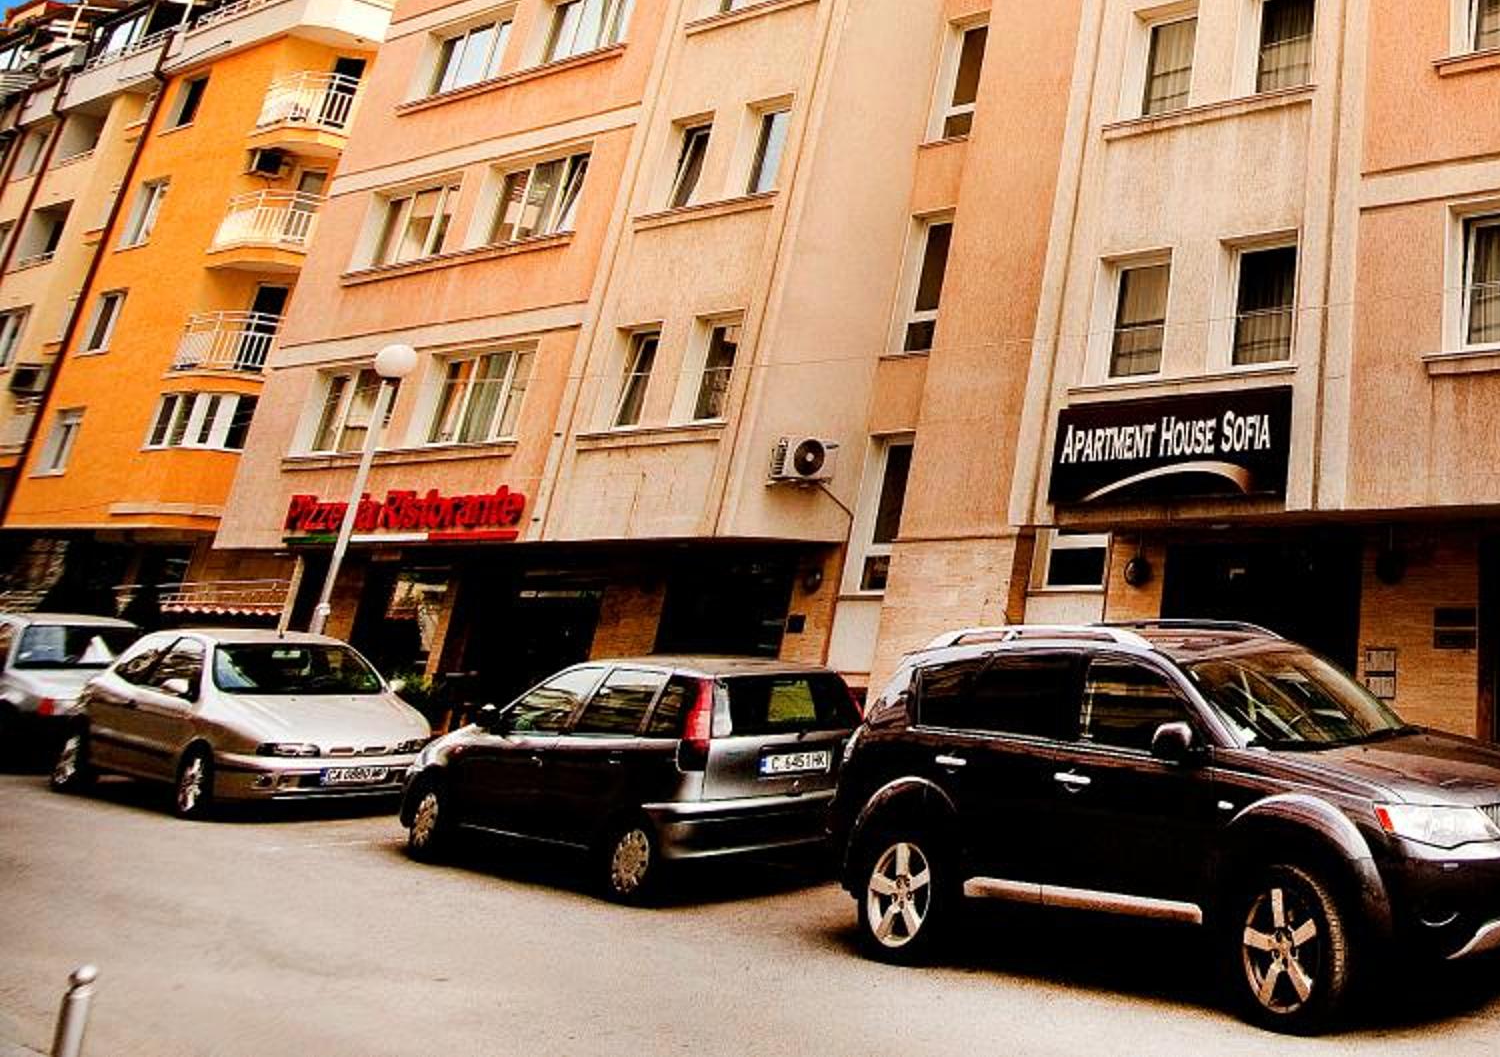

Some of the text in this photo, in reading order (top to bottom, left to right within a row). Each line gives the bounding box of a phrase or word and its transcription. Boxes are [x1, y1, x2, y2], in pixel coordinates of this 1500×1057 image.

[1060, 410, 1271, 463] APARTMENT HOUSE SOFIA
[379, 485, 525, 530] Ristorante
